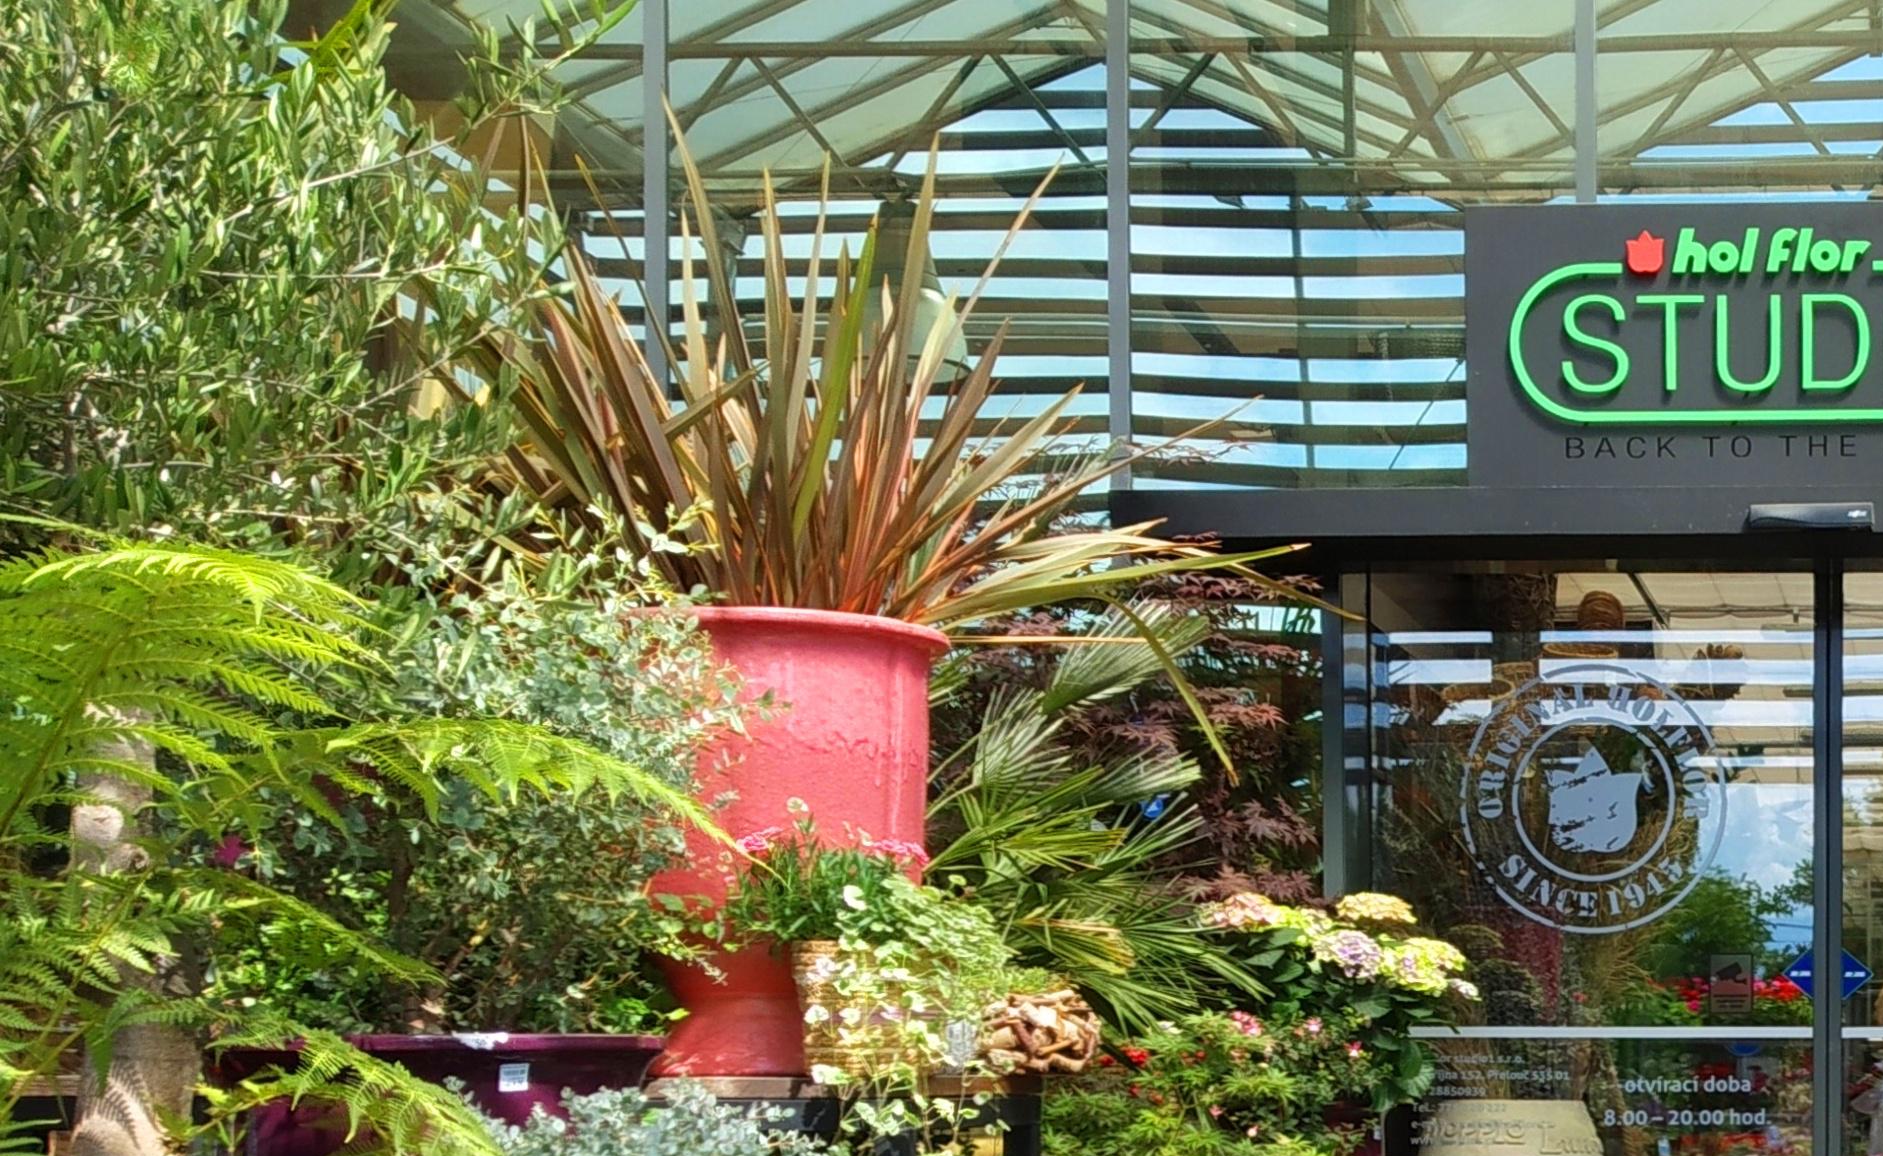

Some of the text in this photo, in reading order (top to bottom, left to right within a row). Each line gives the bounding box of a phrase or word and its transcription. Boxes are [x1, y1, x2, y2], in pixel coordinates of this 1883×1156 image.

[1672, 227, 1872, 274] hol flor
[1565, 434, 1676, 460] BACK
[1703, 434, 1754, 459] TO
[1779, 433, 1857, 458] THE
[1477, 683, 1595, 820] ORIGINAL
[1498, 854, 1598, 917] SINCE
[1624, 1075, 1751, 1093] otvírací doba
[1603, 1108, 1648, 1127] 8.00
[1667, 1109, 1725, 1126] 20.00
[1729, 1108, 1772, 1126] hod.
